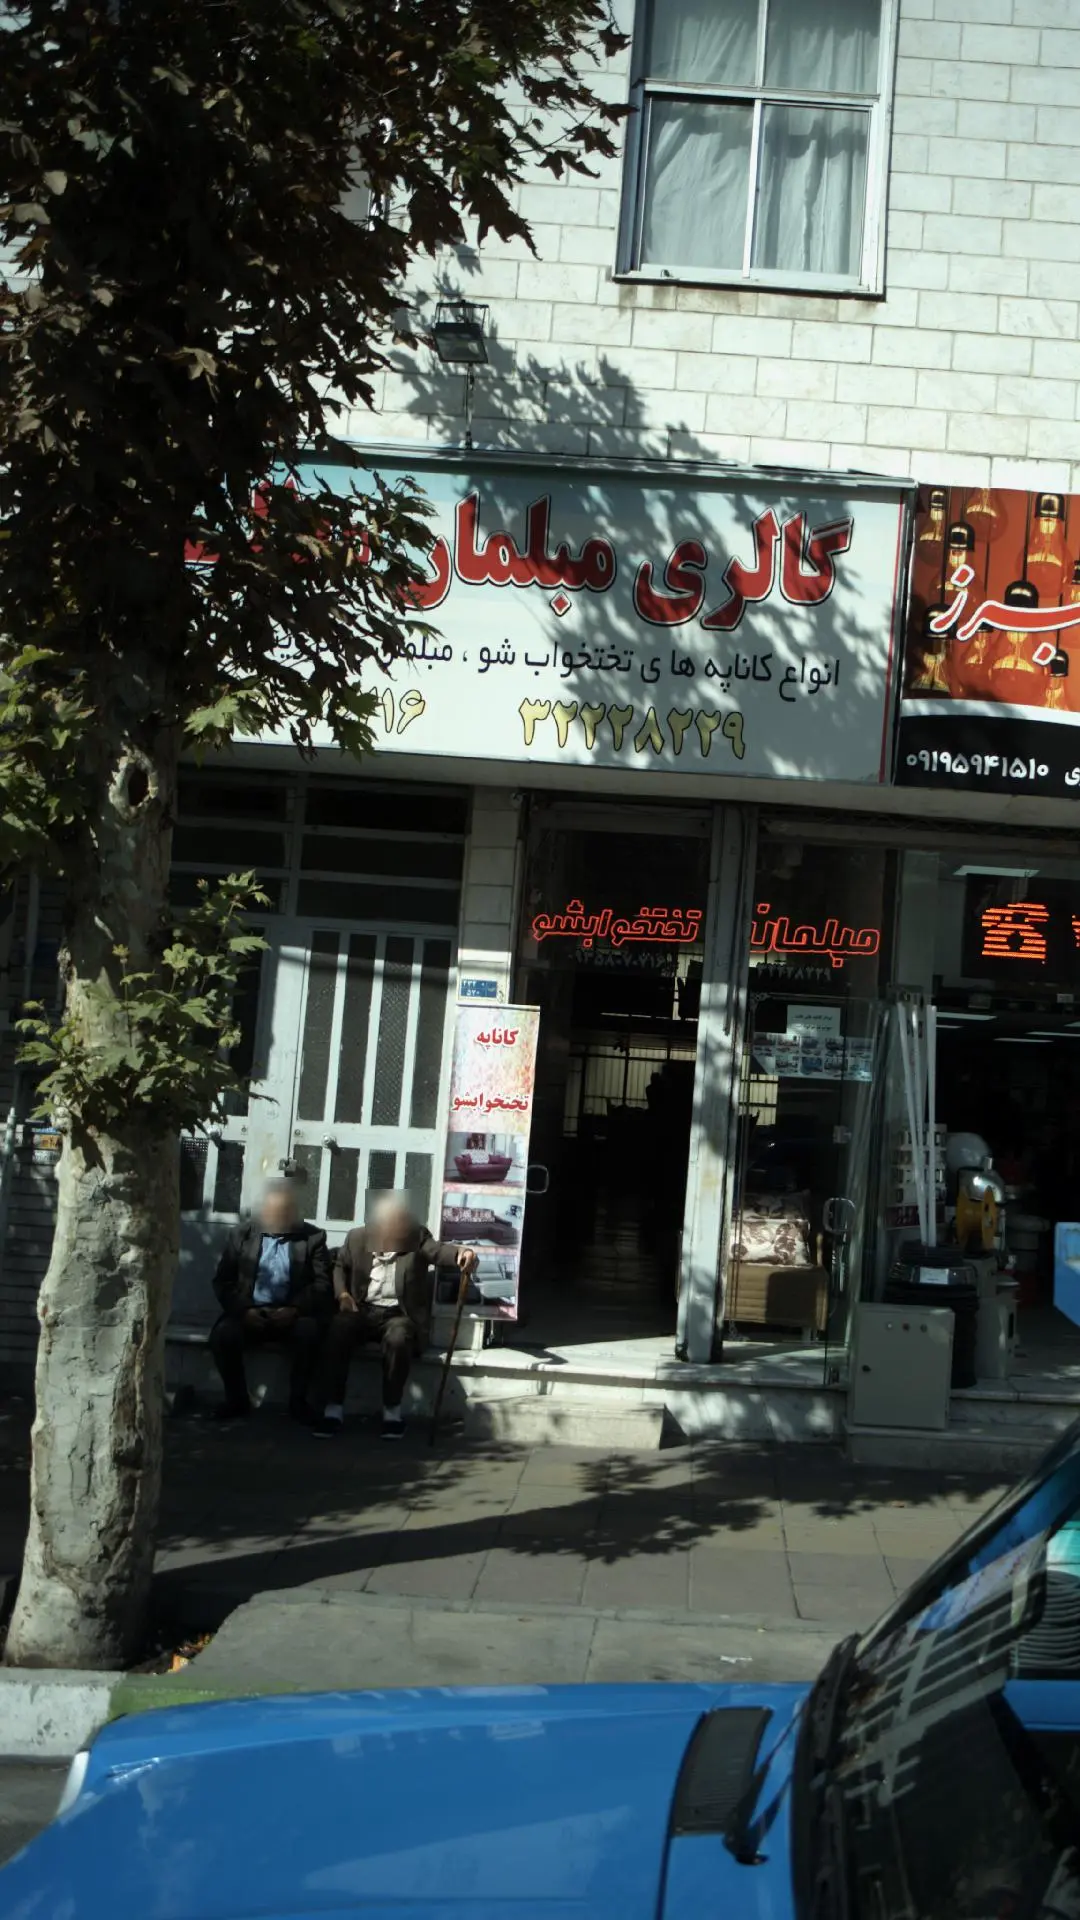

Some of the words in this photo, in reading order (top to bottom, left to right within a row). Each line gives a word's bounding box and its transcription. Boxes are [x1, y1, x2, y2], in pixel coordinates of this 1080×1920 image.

[634, 508, 854, 631] گالری
[930, 563, 1080, 665] برز
[525, 641, 635, 677] تختخواب
[705, 652, 773, 693] کاناپه
[779, 659, 841, 702] انواع
[518, 698, 745, 760] ۳۲۲۲۸۲۲۹
[906, 749, 1050, 779] ۰۹۱۹۵۹۴۱۵۱۰
[531, 898, 703, 949] تختخوابشو
[476, 1027, 519, 1051] کاناپه
[452, 1092, 530, 1113] تختخوابشو
